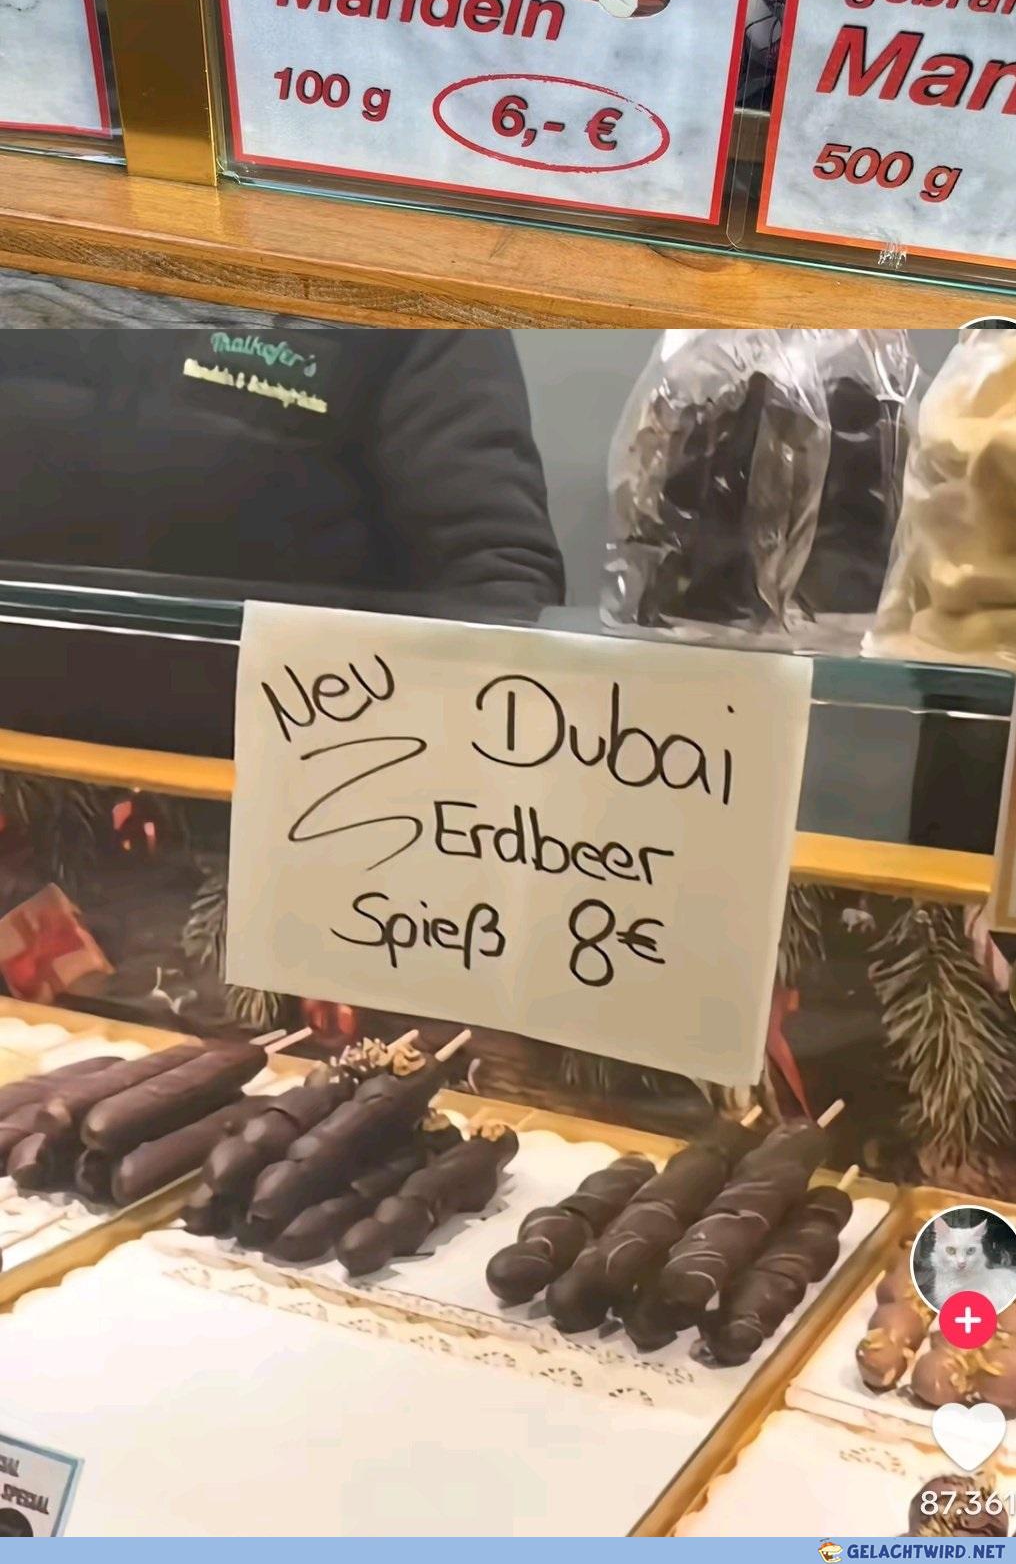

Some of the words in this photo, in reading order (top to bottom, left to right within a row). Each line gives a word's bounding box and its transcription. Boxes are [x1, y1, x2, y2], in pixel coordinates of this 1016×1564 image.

[273, 67, 350, 108] 100
[361, 84, 391, 122] g
[491, 95, 566, 148] 6,-
[584, 106, 624, 151] €
[813, 143, 914, 189] 500
[919, 165, 963, 203] g
[261, 654, 396, 743] Neu
[471, 674, 736, 806] Dubai
[433, 800, 675, 885] Erdbeer
[330, 891, 507, 970] Spieß
[568, 898, 666, 987] 8€
